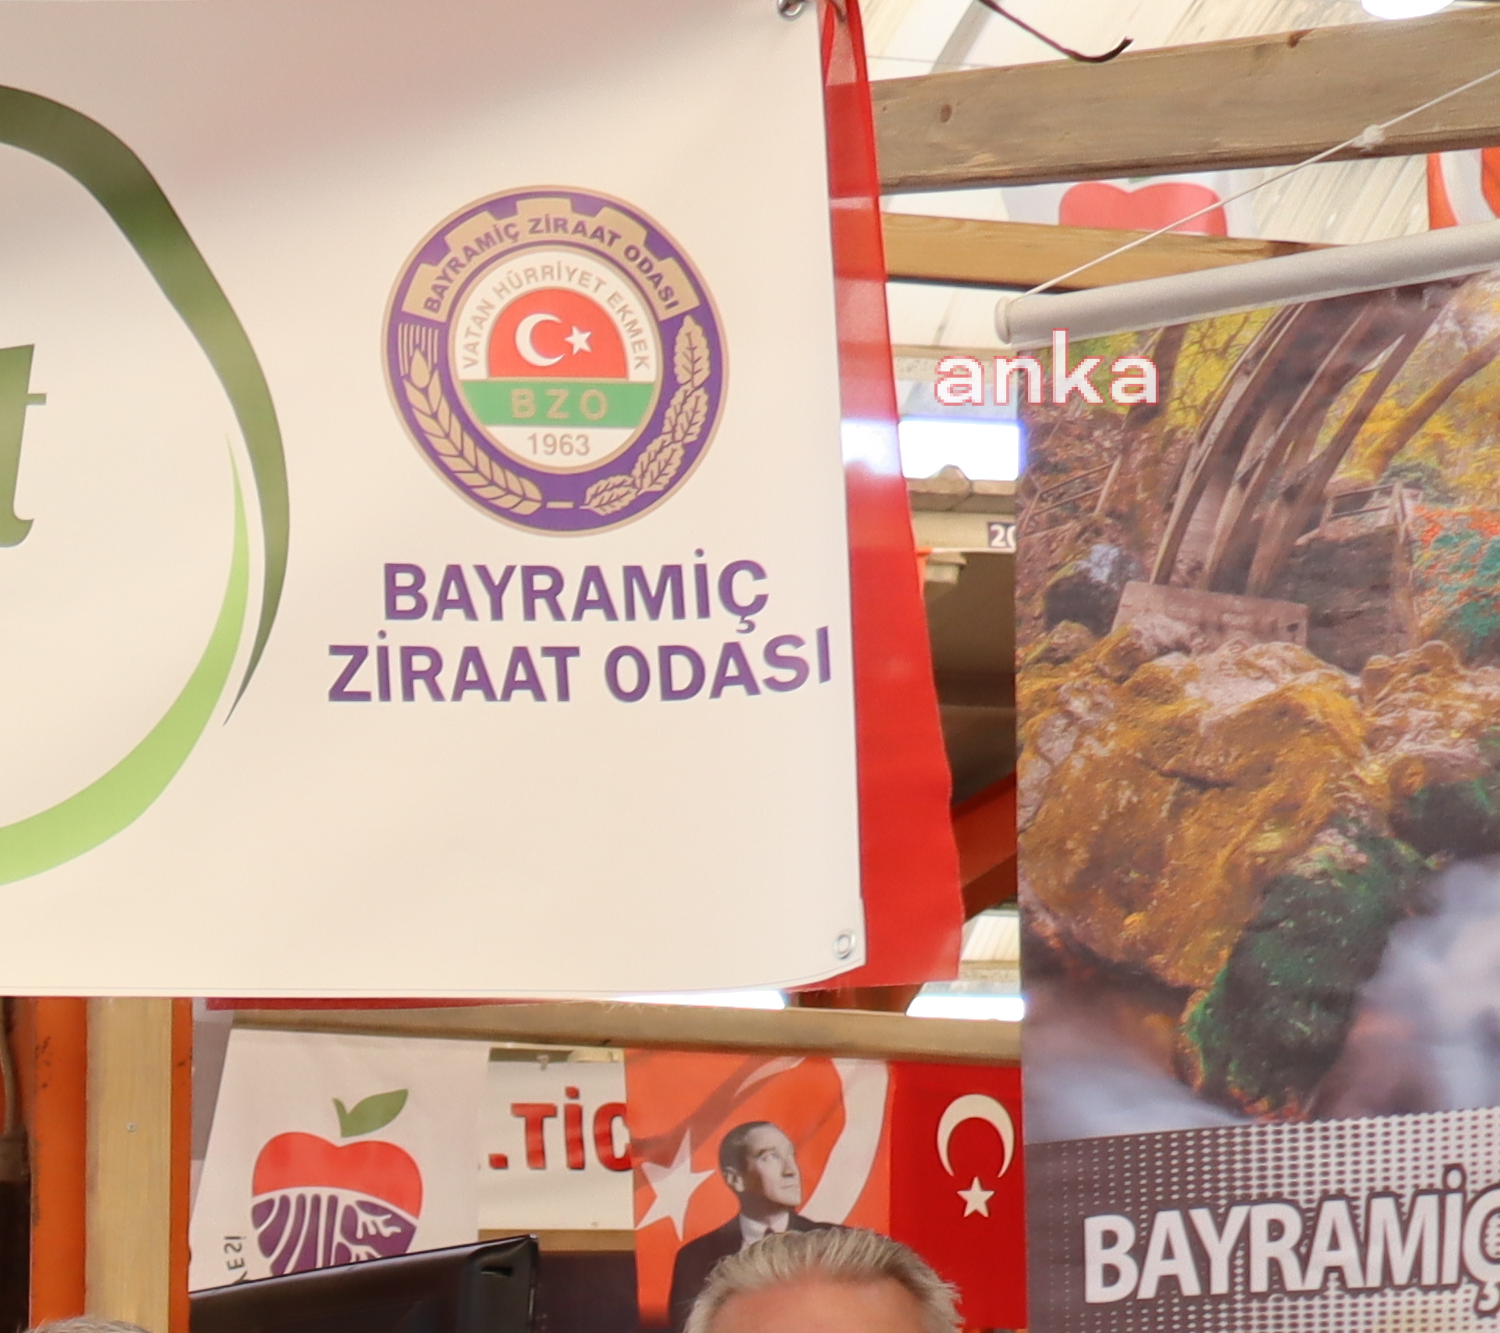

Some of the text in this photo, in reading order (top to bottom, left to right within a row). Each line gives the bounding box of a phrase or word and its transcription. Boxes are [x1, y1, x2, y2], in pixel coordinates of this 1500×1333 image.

[423, 213, 680, 314] BAYRAMİÇ ZİRAAT ODASI
[462, 260, 651, 371] VATAN HÜRRİYET EKMEK
[526, 432, 591, 457] 1963
[383, 547, 770, 634] BAYRAMİÇ
[327, 626, 832, 703] ZİRAAT ODASI
